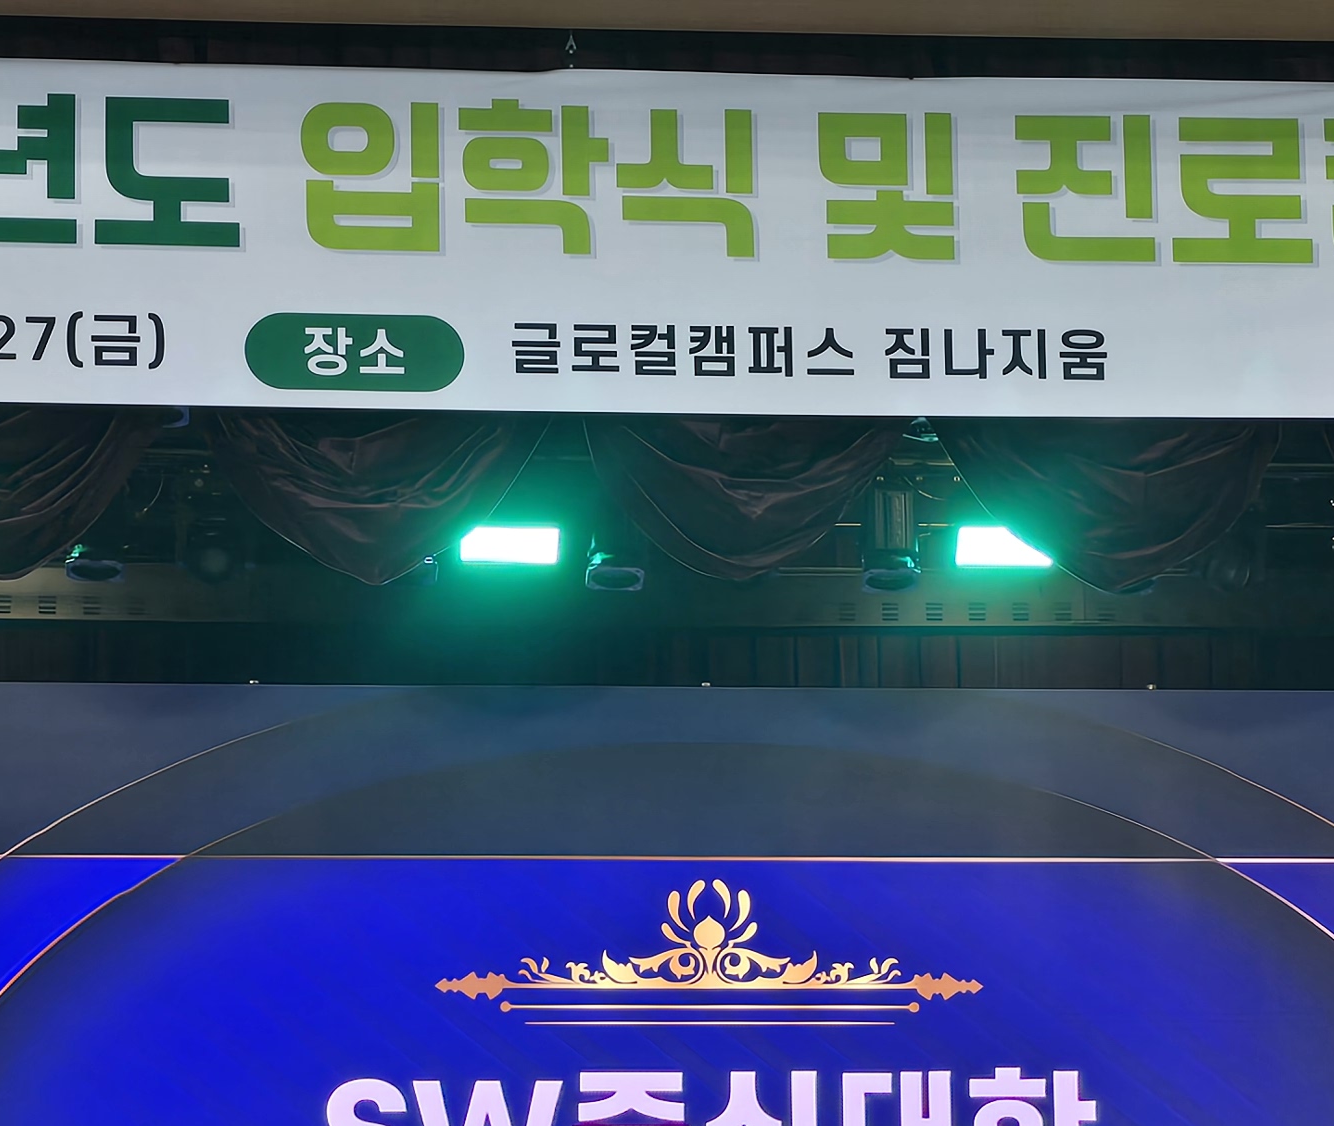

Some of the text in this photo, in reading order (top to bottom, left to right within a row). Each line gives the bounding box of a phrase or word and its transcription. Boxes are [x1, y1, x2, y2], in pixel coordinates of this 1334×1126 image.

[300, 98, 757, 257] 입학식
[818, 112, 957, 261] 및
[303, 327, 406, 376] 장소
[511, 323, 855, 379] 글로컬캠퍼스
[884, 327, 1108, 382] 짐나지움
